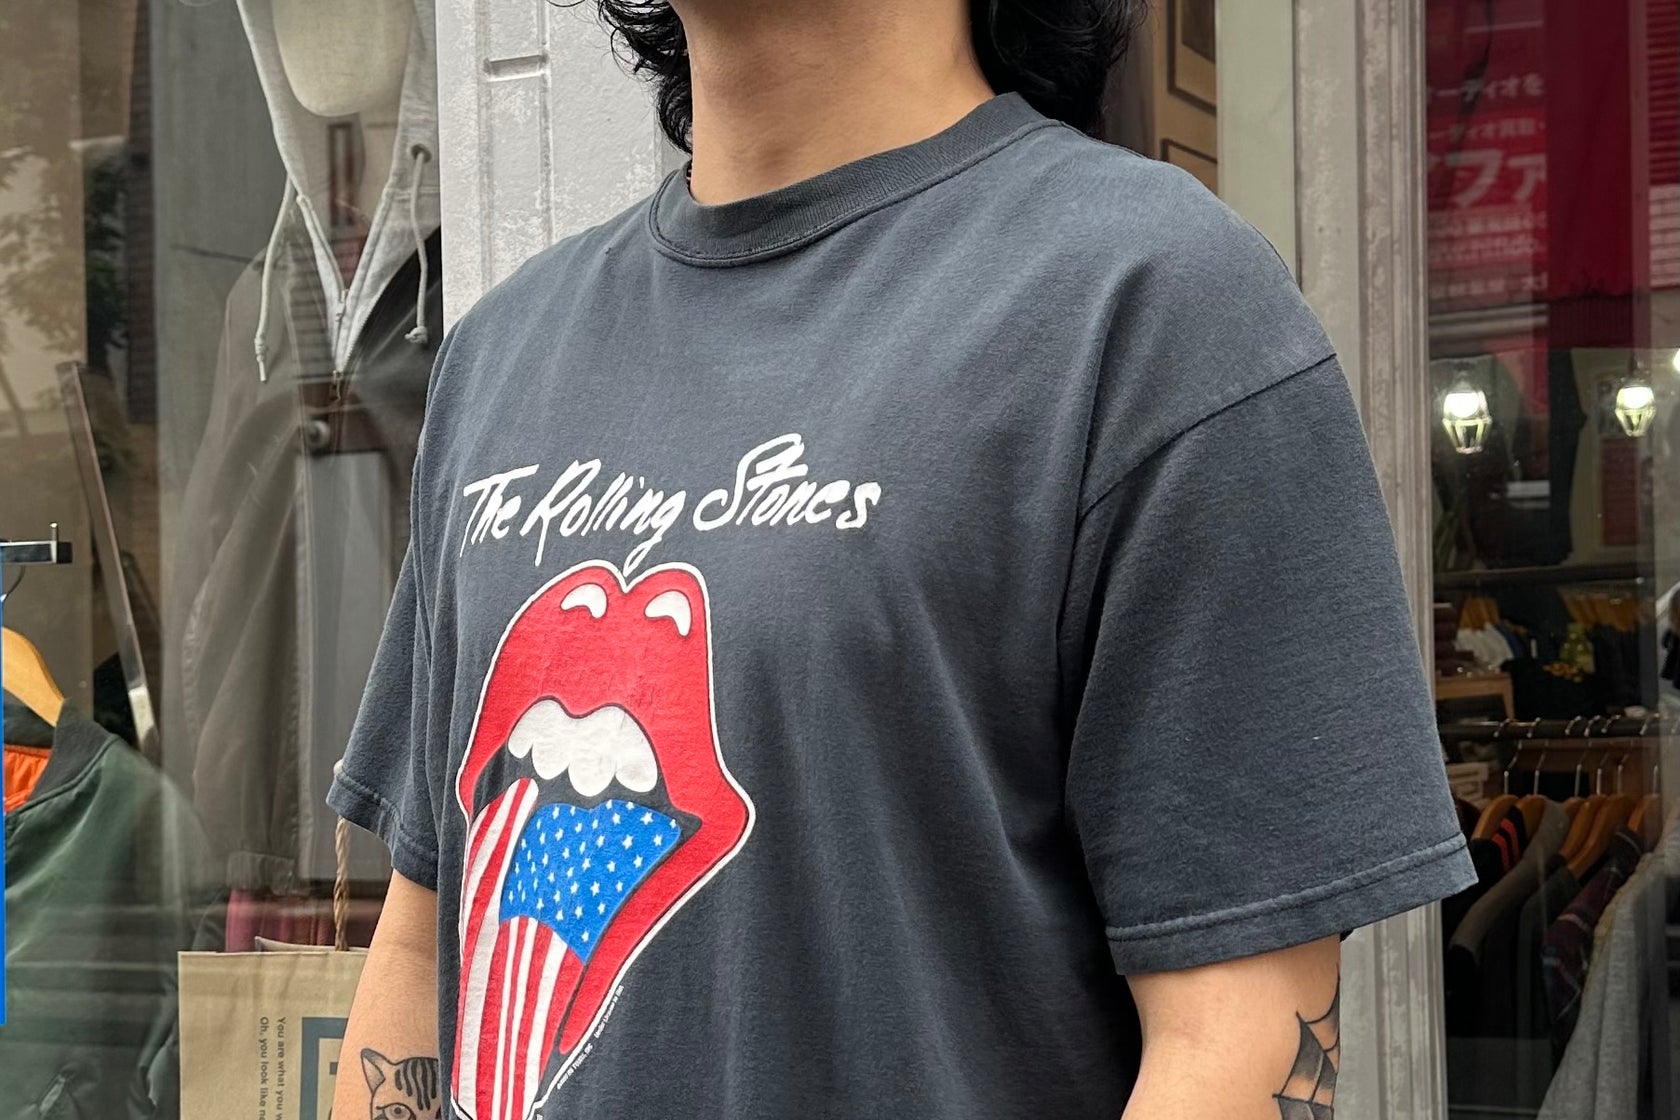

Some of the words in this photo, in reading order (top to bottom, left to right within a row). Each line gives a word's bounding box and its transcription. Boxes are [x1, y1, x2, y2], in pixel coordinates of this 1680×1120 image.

[460, 464, 540, 558] The
[520, 458, 687, 577] Rolling
[693, 432, 882, 531] Stones
[258, 1016, 269, 1035] Oh,
[276, 1016, 287, 1038] You
[258, 1039, 268, 1058] you
[277, 1041, 285, 1058] are
[259, 1061, 269, 1085] look
[276, 1061, 286, 1086] what
[258, 1088, 269, 1107] like
[275, 1090, 285, 1110] you
